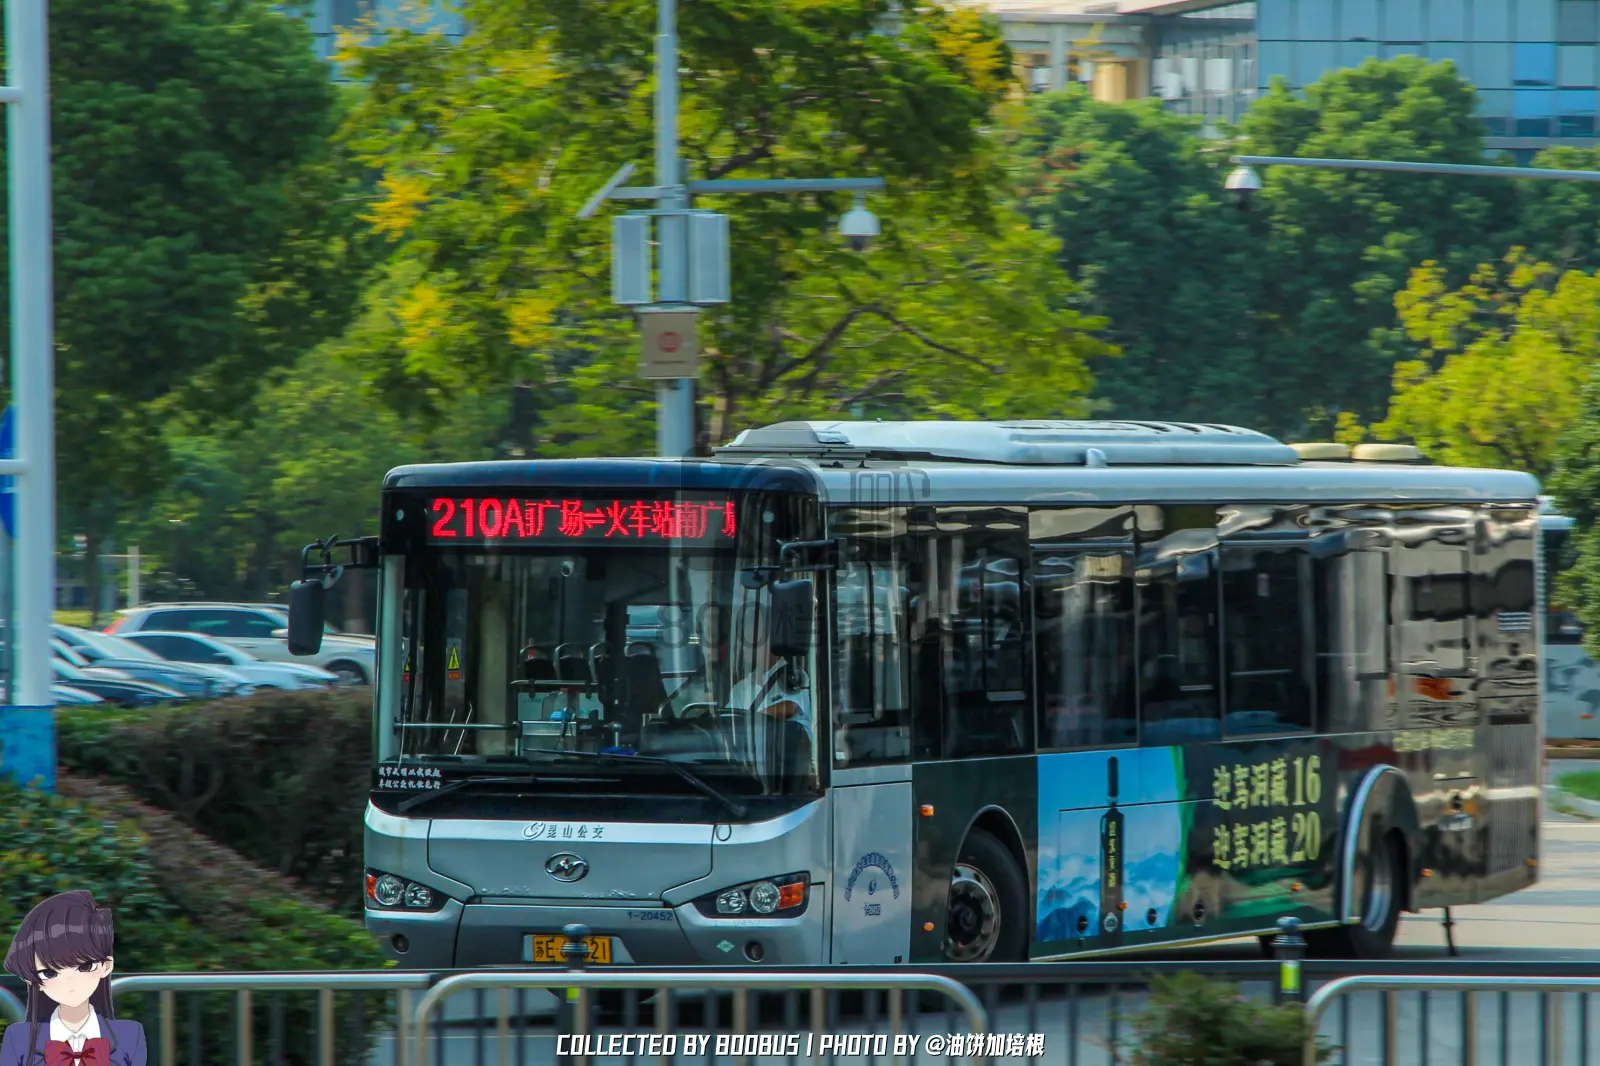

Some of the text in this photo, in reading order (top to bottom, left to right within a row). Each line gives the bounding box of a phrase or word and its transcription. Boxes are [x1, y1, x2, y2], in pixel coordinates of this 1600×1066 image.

[432, 498, 526, 538] 210A
[546, 823, 604, 839] 昆山公交
